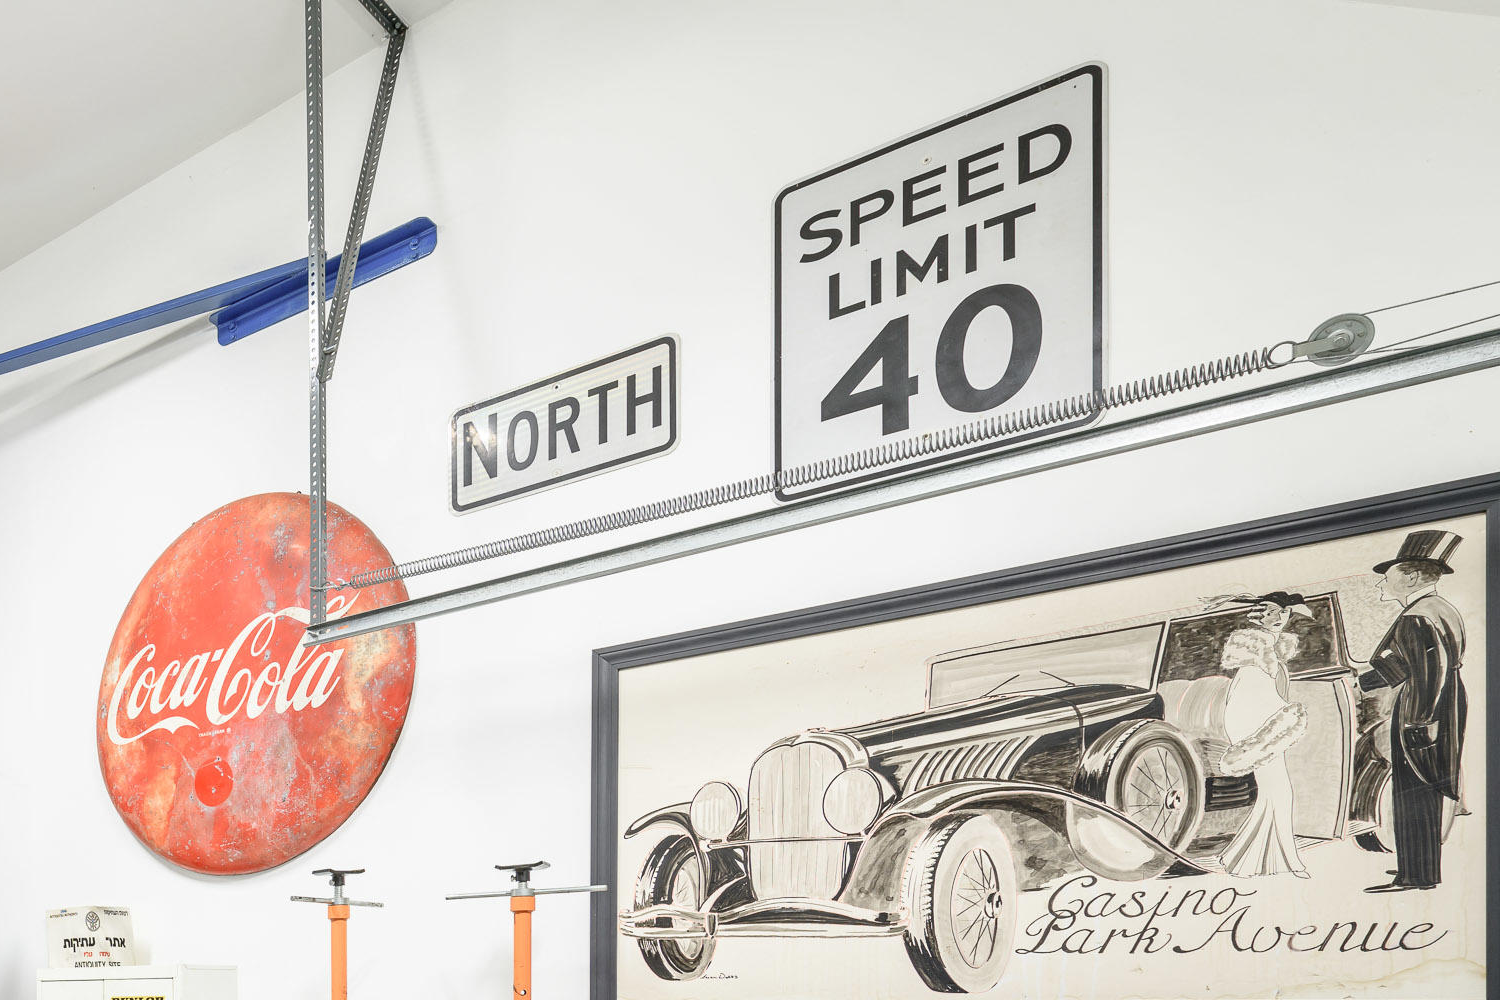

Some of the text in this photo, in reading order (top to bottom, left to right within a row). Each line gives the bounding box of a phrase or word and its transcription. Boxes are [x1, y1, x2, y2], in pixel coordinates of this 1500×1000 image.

[799, 123, 1073, 264] SPEED
[828, 203, 1037, 320] LIMIT
[461, 364, 663, 488] NORTH
[820, 283, 1043, 437] 40
[107, 591, 359, 746] Coca-Cola
[1172, 904, 1452, 956] Avenue
